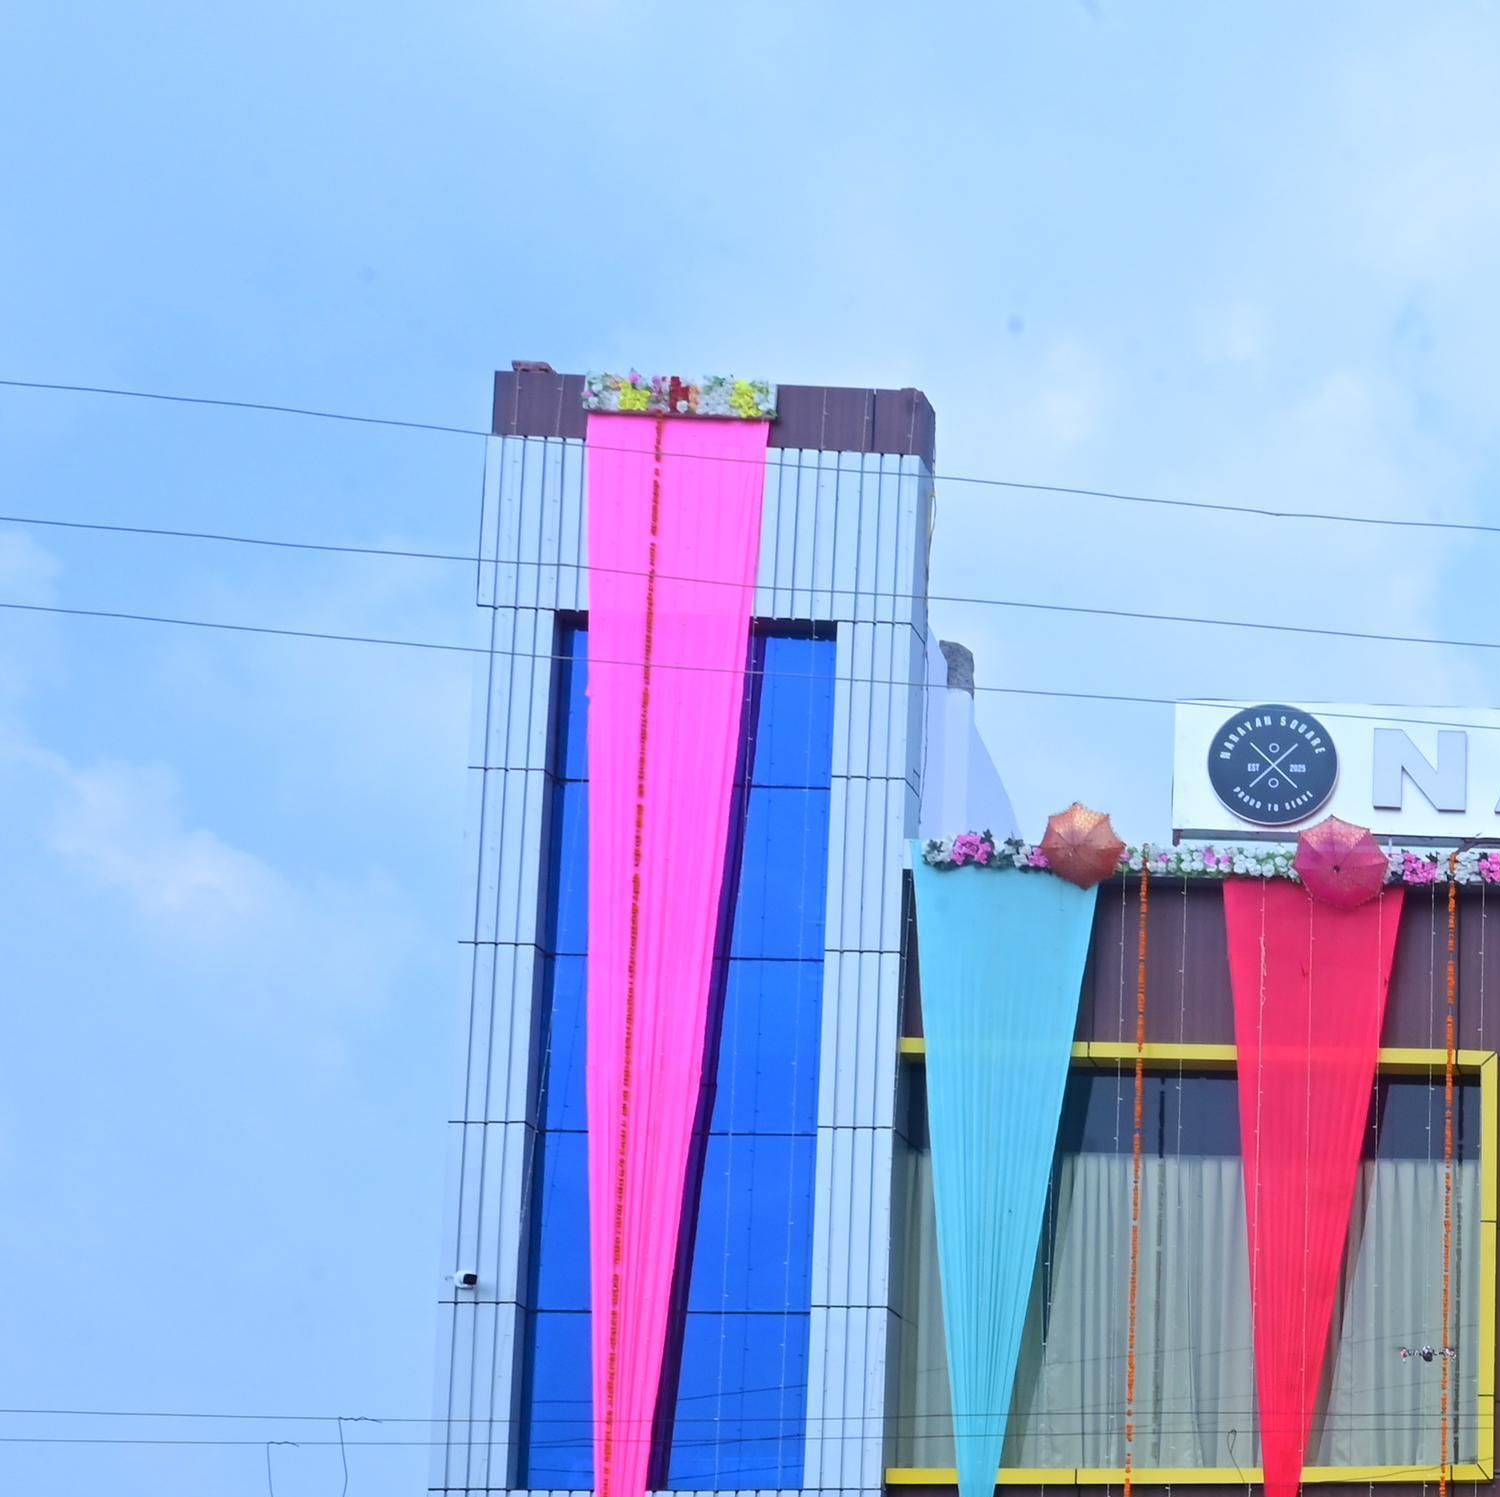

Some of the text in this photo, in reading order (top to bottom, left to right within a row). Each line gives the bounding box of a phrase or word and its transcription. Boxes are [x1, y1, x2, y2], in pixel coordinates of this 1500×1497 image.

[1220, 715, 1326, 760] NARAYAN SQUARE
[1247, 763, 1260, 772] EST
